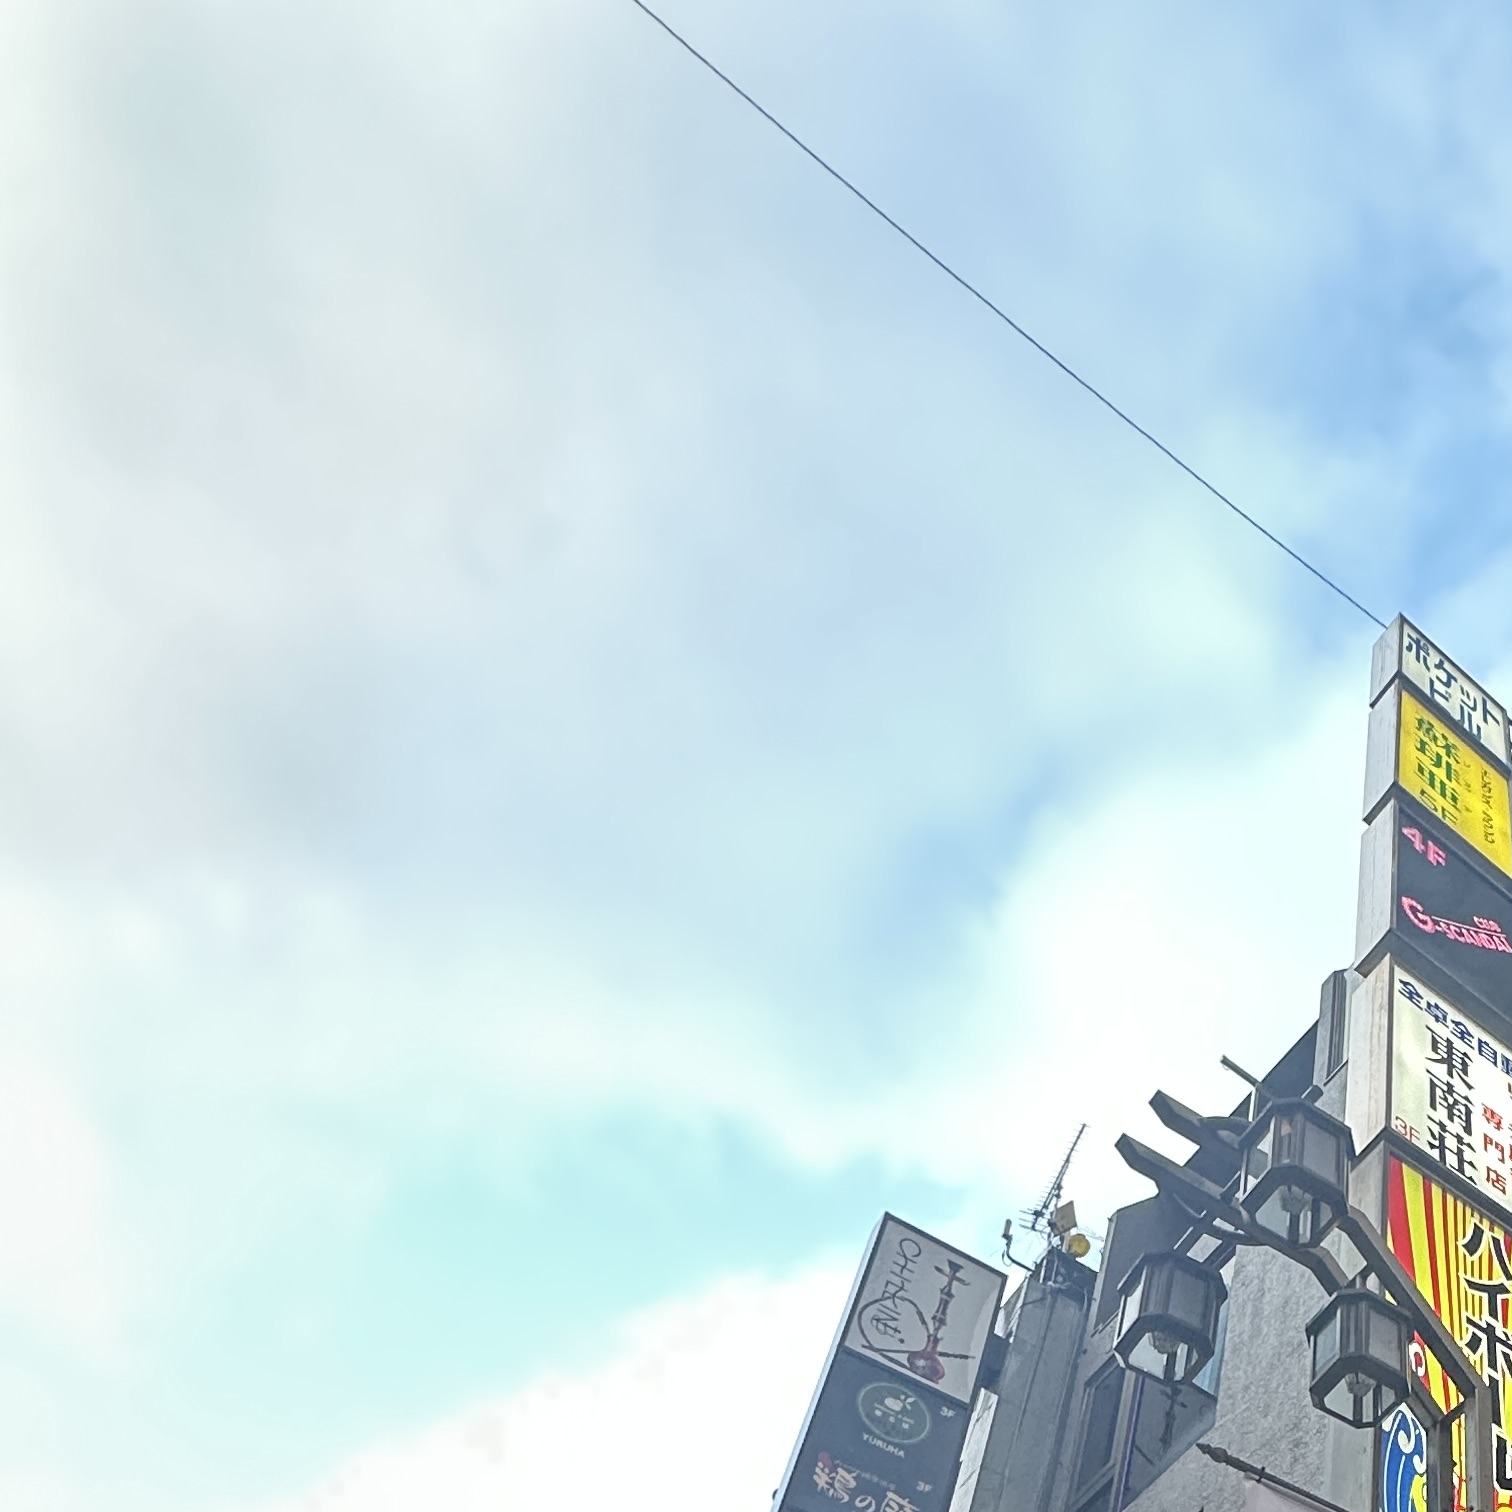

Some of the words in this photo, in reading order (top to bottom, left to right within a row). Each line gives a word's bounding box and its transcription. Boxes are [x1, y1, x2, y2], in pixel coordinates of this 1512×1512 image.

[1405, 631, 1500, 727] ポケット
[1428, 675, 1482, 741] ビル
[1419, 788, 1459, 826] 5F
[1401, 826, 1447, 867] 4F
[1394, 1114, 1421, 1144] 3F
[1425, 1024, 1478, 1186] 東南荘
